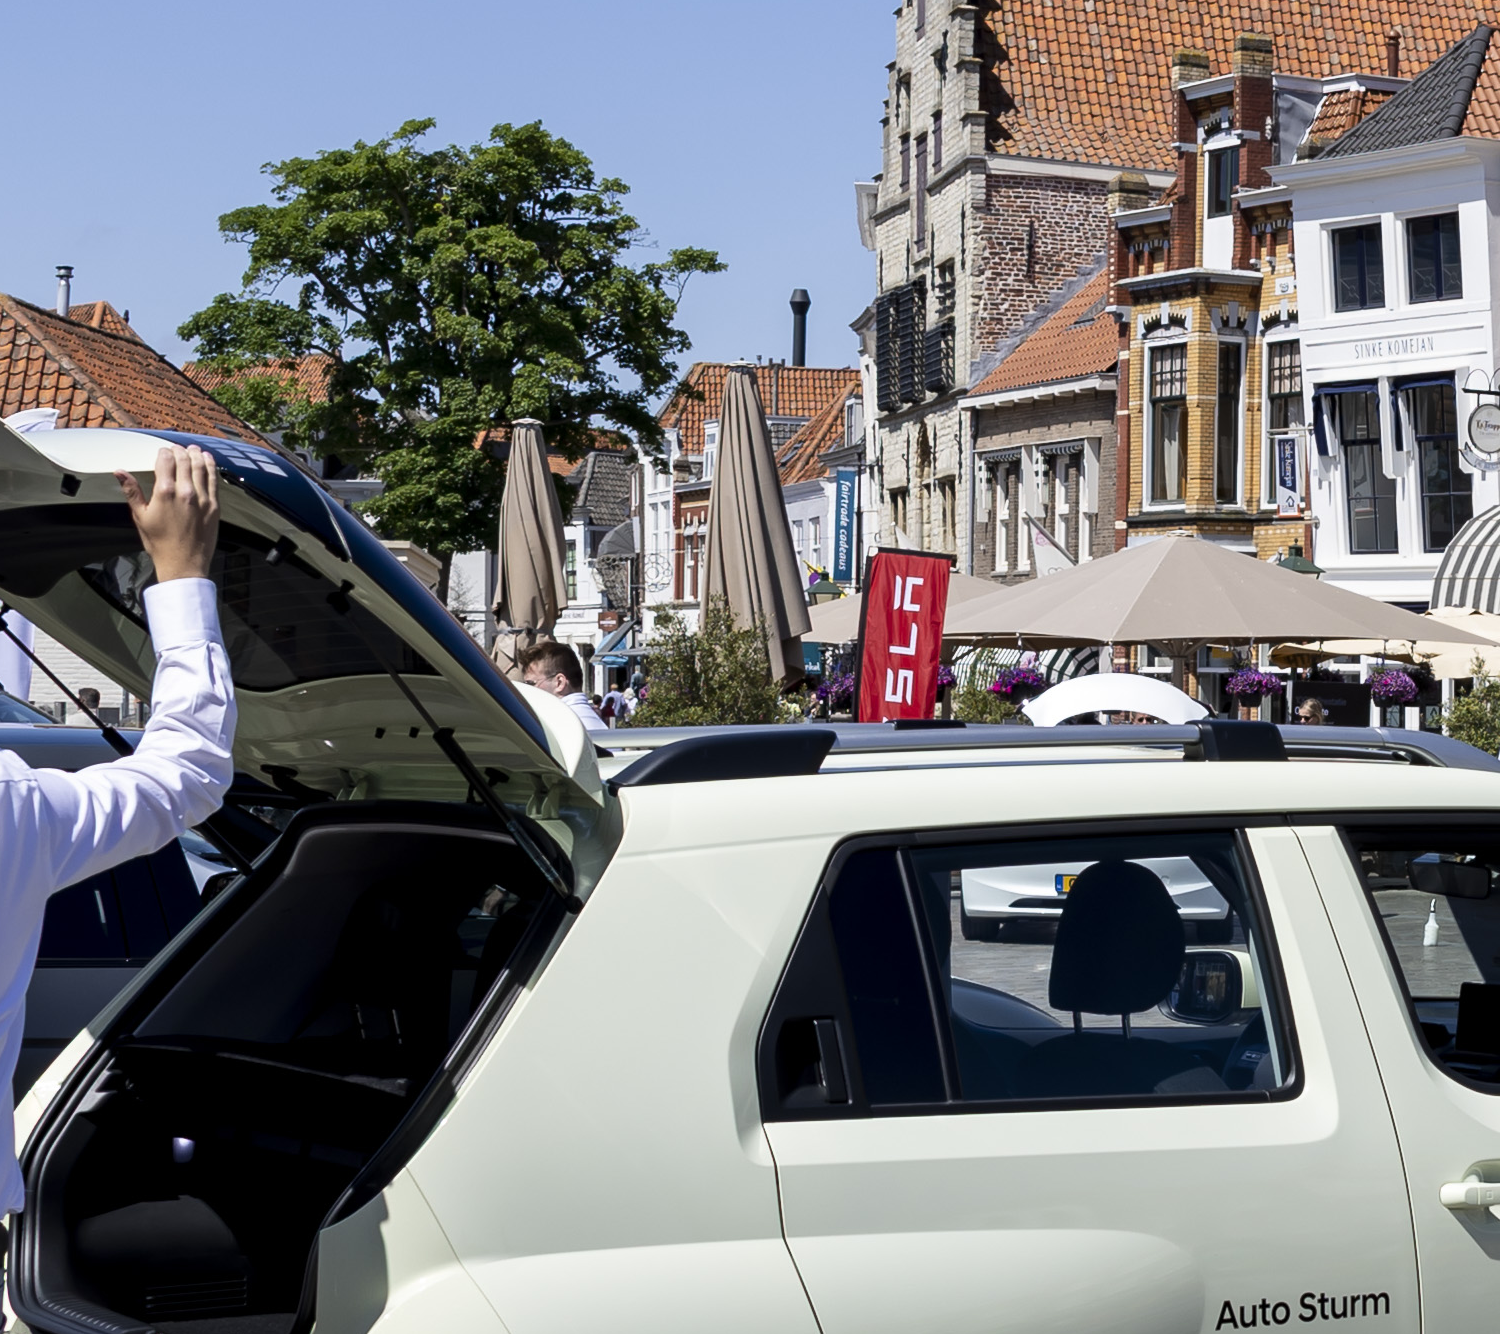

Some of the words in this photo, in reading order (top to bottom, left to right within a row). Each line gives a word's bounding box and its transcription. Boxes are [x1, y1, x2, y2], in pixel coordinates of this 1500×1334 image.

[1354, 342, 1383, 359] SINKE
[1387, 336, 1434, 356] KOMEJAN
[840, 480, 852, 527] fairtrade
[838, 527, 850, 572] cadeaus
[883, 575, 925, 723] SLA
[1215, 1299, 1291, 1331] Auto
[1297, 1292, 1391, 1322] Sturm
